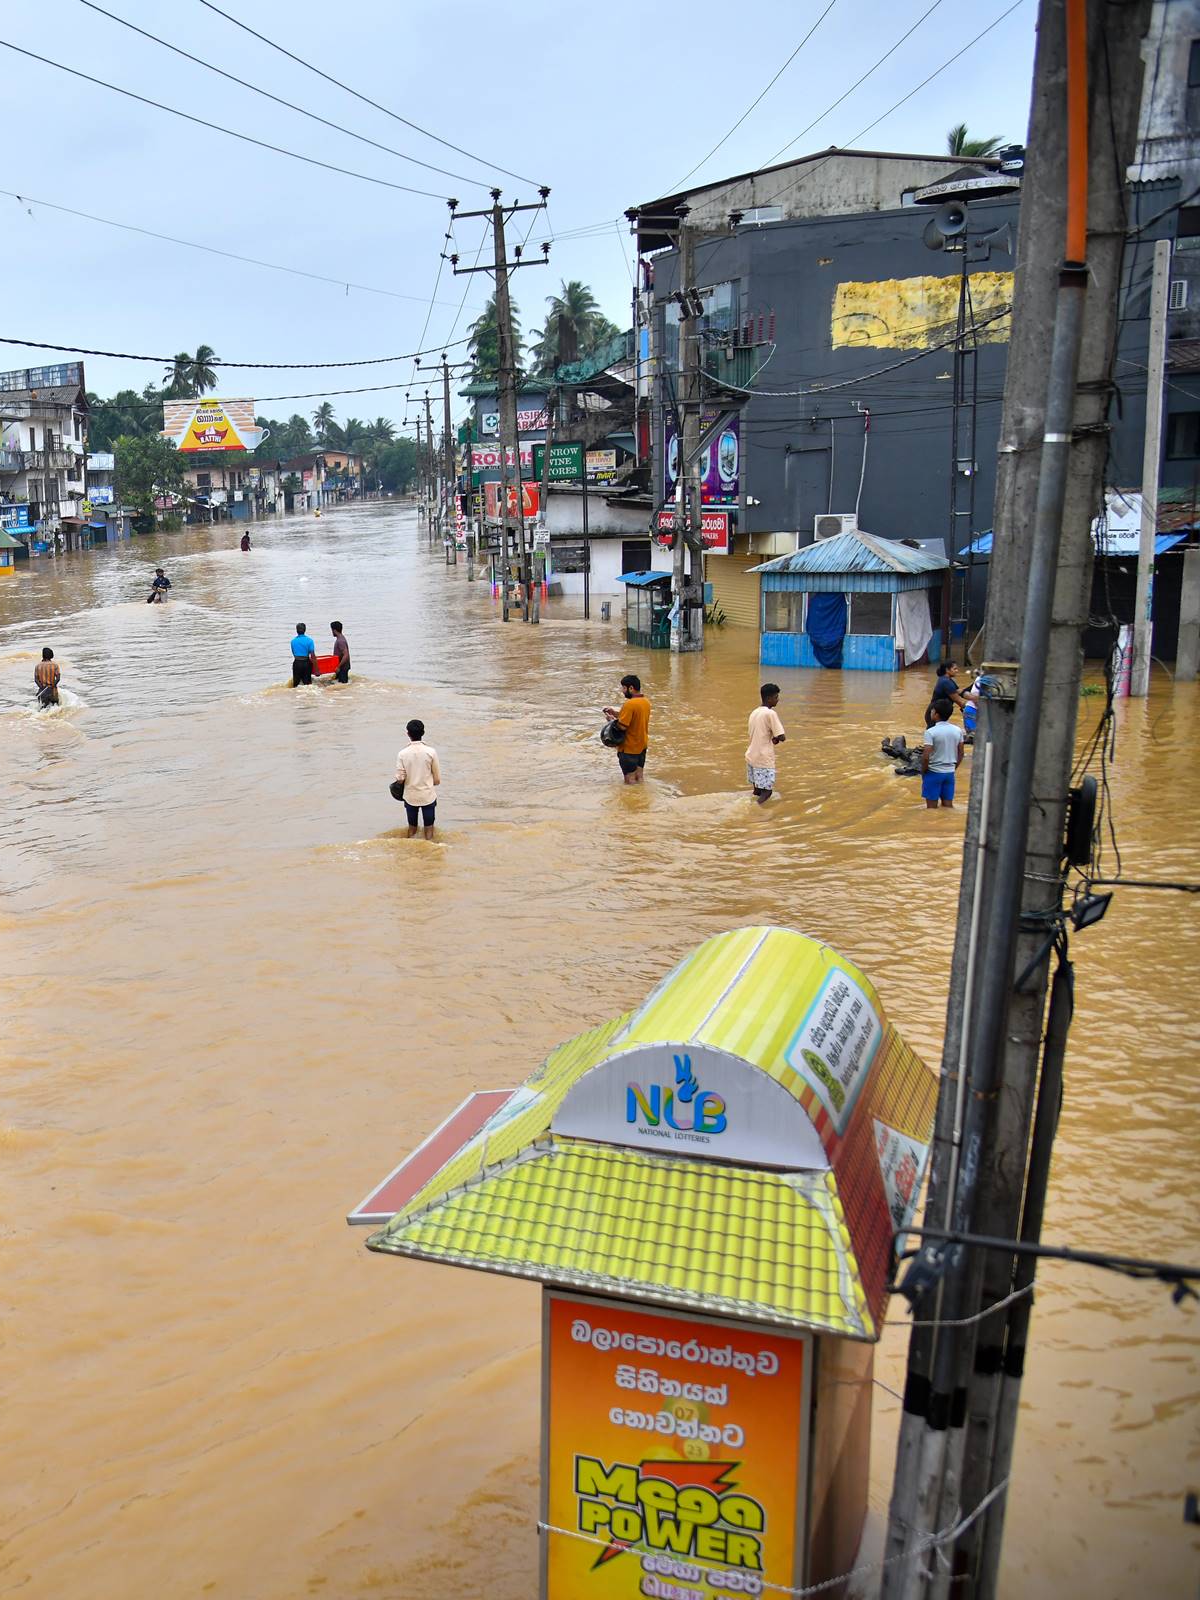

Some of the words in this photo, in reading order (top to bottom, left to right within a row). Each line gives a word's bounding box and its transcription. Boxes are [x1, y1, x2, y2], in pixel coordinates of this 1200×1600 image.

[538, 448, 578, 457] SNROW
[638, 1127, 671, 1138] NATIONAL
[674, 1133, 710, 1144] LOTTERIES
[571, 1320, 778, 1376] බලාපොරොත්තුව
[614, 1364, 727, 1406] සිහිනයක්
[609, 1406, 744, 1448] නොවන්නට
[675, 1407, 694, 1421] 07
[578, 1498, 764, 1571] POWER
[641, 1554, 700, 1583] මෙගා
